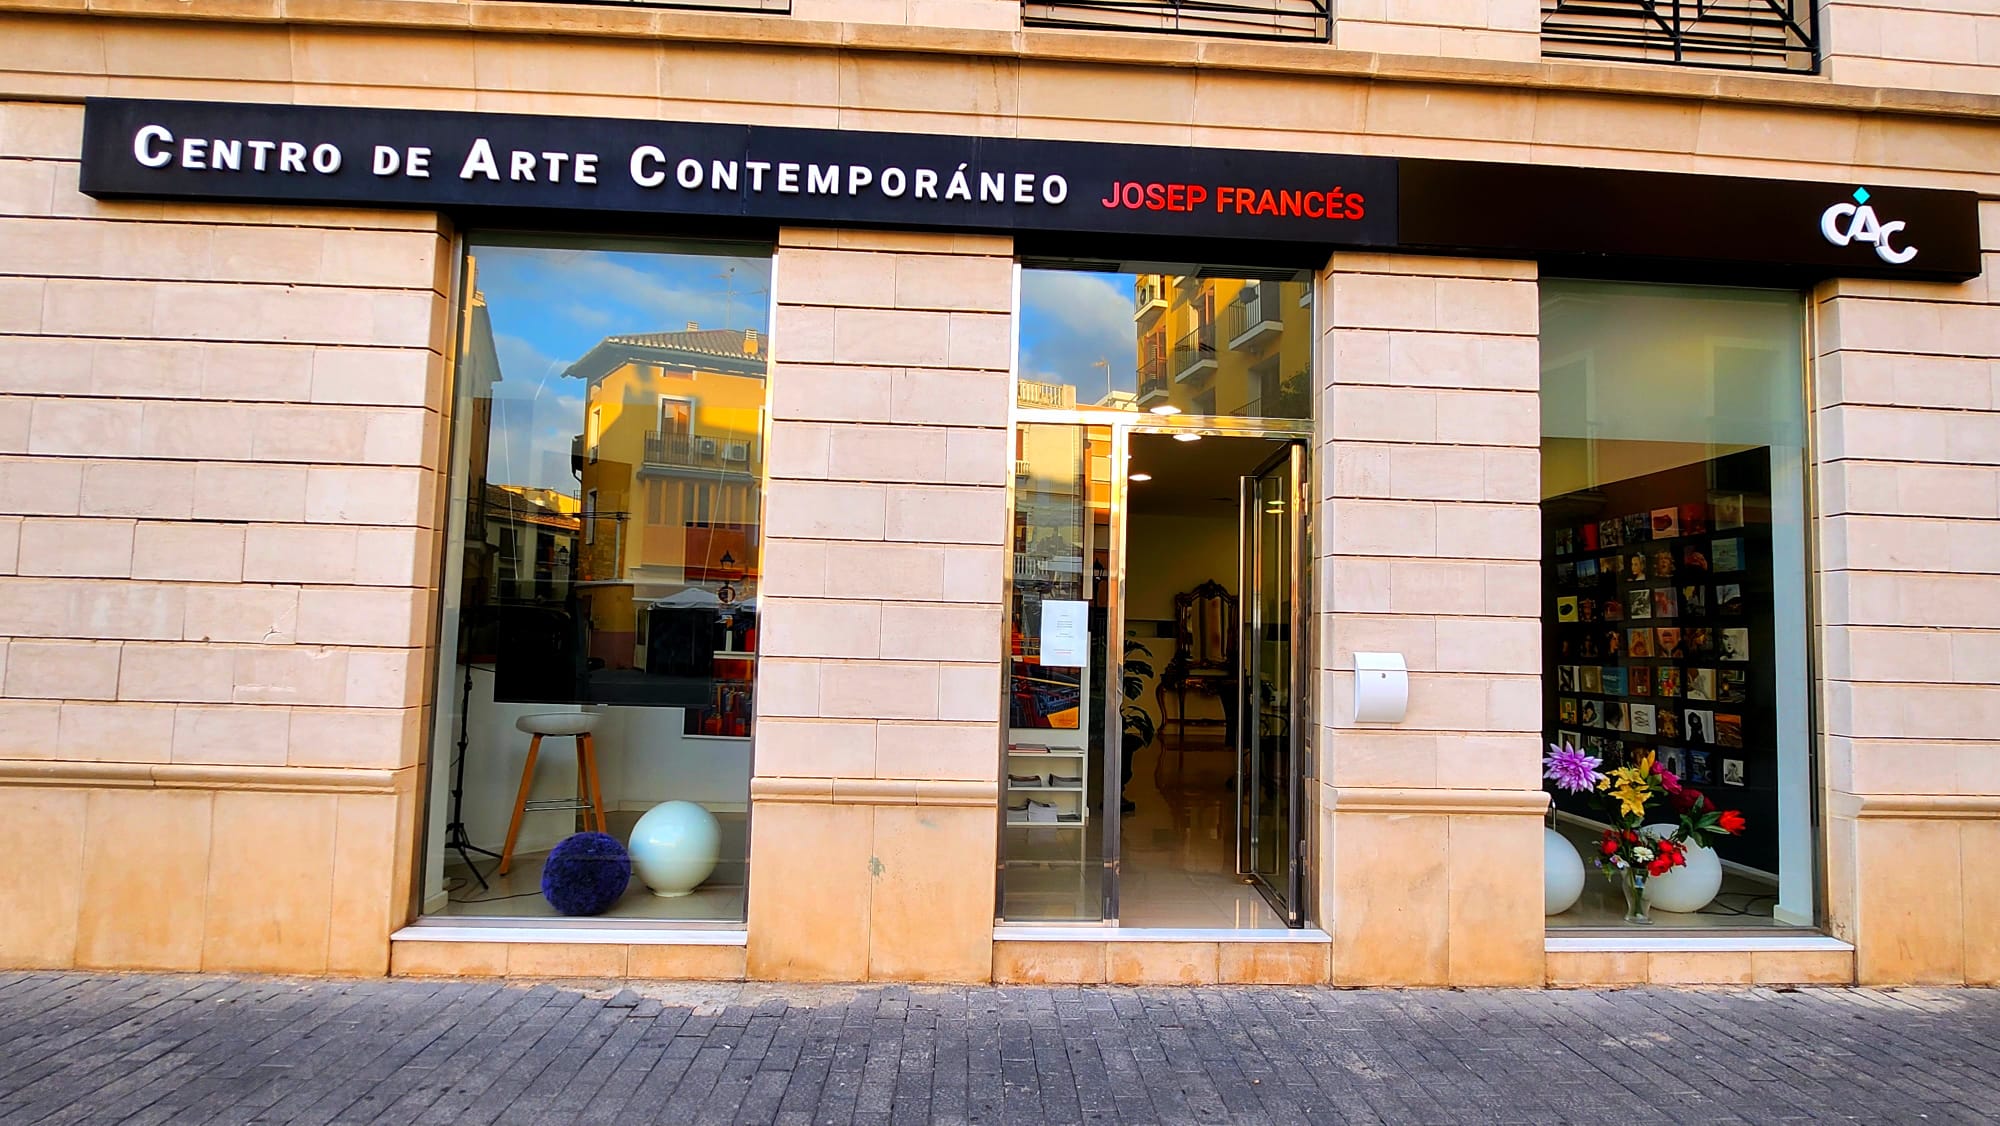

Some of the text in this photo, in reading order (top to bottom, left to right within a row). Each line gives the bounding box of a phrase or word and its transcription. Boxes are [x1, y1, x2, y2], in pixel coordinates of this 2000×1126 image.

[133, 124, 1069, 205] CENTRO DE ARTE CONTEMPORÁNEO
[1101, 181, 1365, 221] JOSEP FRANCÉS
